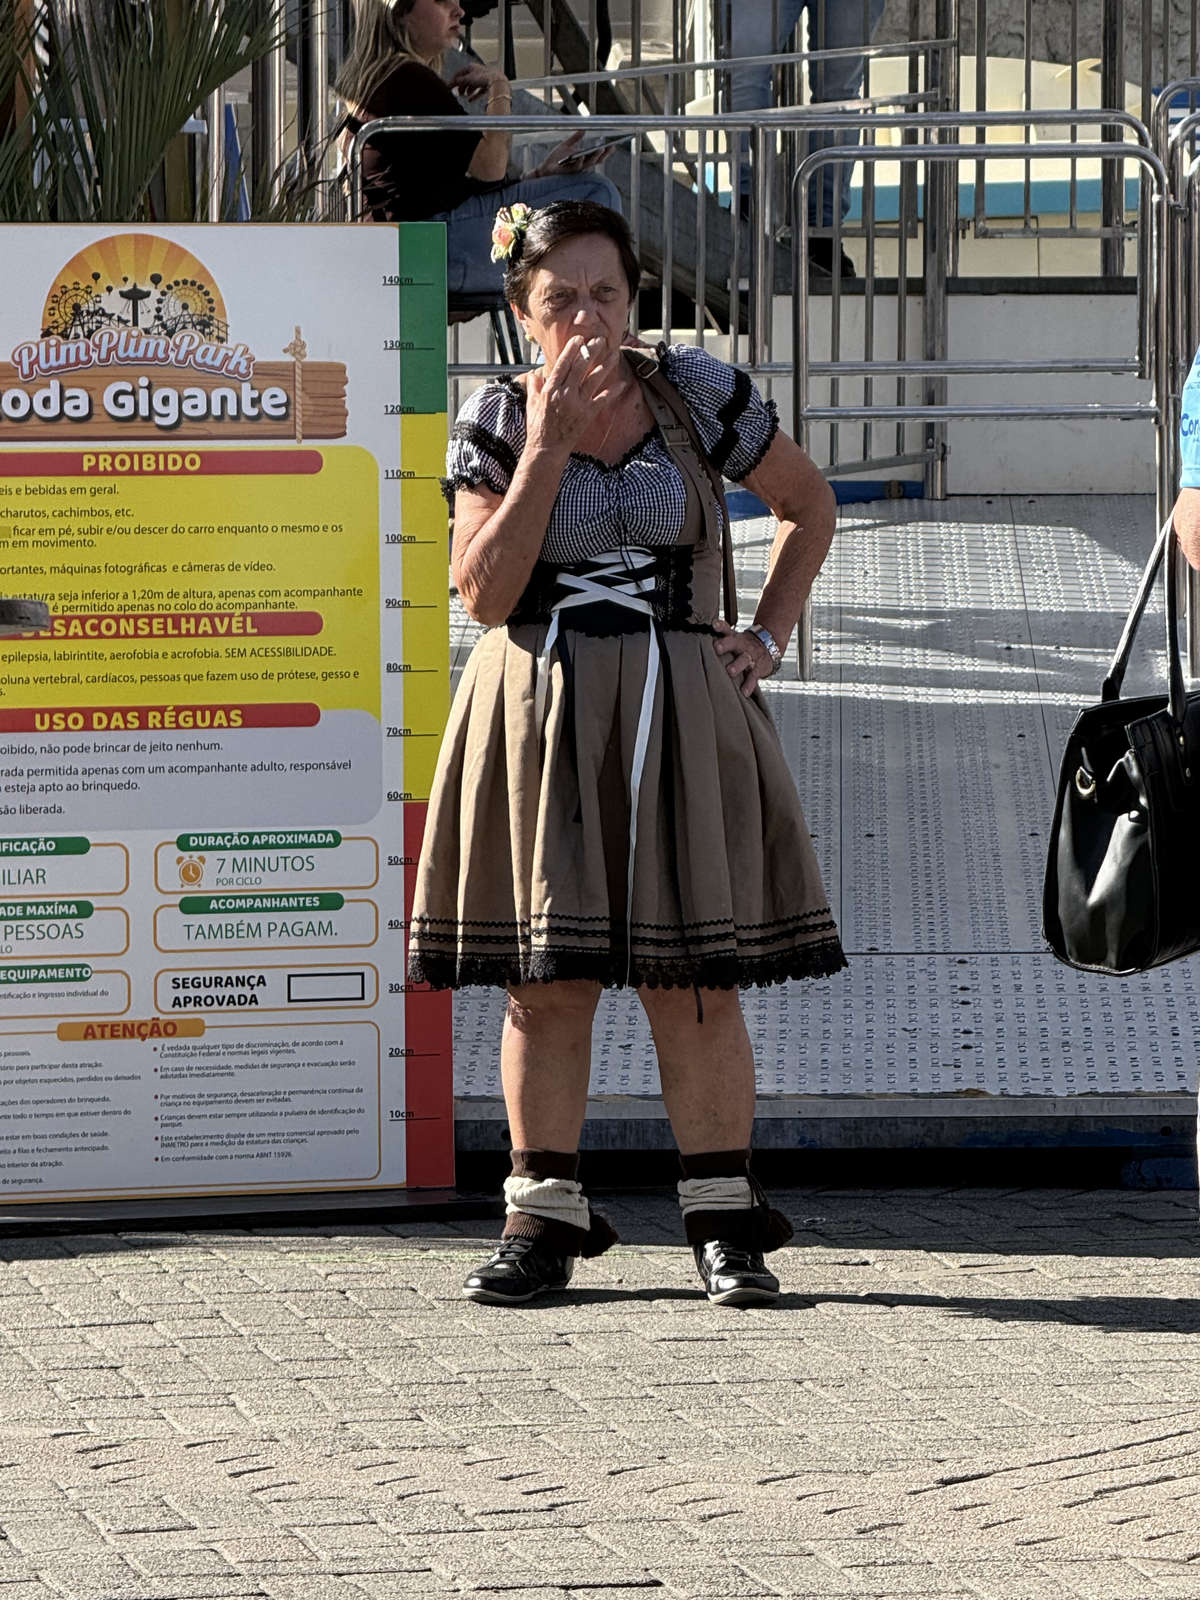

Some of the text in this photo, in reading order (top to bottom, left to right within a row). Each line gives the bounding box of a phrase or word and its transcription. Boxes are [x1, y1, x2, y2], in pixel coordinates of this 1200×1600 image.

[383, 276, 413, 285] 140cm
[383, 340, 414, 349] 130cm
[13, 328, 255, 379] Plim Plim Park
[103, 377, 288, 426] Gigante
[384, 405, 415, 413] 120cm
[83, 453, 200, 471] PROIBIDO
[384, 469, 415, 478] 110cm
[15, 487, 22, 495] e
[24, 484, 67, 495] bebidas
[69, 486, 86, 495] em
[89, 483, 118, 497] geral.
[52, 506, 111, 518] cachimbos,
[114, 507, 133, 517] etc.
[12, 523, 342, 537] ficar em pé, subir e/ou descer do carro enquanto o mesmo e os
[11, 539, 29, 548] em
[32, 537, 96, 548] movimento.
[385, 534, 416, 542] 100cm
[50, 562, 101, 576] máquinas
[104, 561, 167, 575] fotográficas
[172, 564, 178, 572] e
[181, 561, 224, 574] câmeras
[227, 561, 240, 571] de
[243, 560, 275, 571] vídeo.
[58, 590, 78, 602] seja
[81, 589, 120, 602] inferior
[122, 591, 128, 599] a
[132, 588, 164, 601] 1,20m
[166, 587, 180, 599] de
[182, 587, 216, 601] altura,
[218, 589, 255, 601] apenas
[258, 589, 281, 600] com
[283, 586, 363, 599] acompanhante
[52, 600, 297, 614] é permitido apenas no colo do acompanhante.
[385, 598, 410, 607] 90cm
[22, 614, 259, 638] SACONSELHAVÉL
[1, 646, 336, 664] epilepsia, labirintite, aerofobia e acrofobia. SEM ACESSIBILIDADE.
[386, 663, 411, 672] 80cm
[32, 672, 82, 684] vertebral,
[85, 672, 137, 684] cardíacos,
[140, 673, 180, 685] pessoas
[183, 673, 203, 684] que
[206, 670, 237, 681] fazem
[240, 672, 258, 680] uso
[261, 669, 274, 680] de
[277, 669, 318, 682] prótese,
[320, 670, 350, 681] gesso
[352, 670, 359, 679] e
[35, 706, 244, 732] USO DAS RÉGUAS
[386, 727, 412, 736] 70cm
[40, 743, 60, 753] não
[63, 742, 90, 755] pode
[93, 742, 130, 753] brincar
[133, 741, 146, 752] de
[148, 741, 172, 754] jeito
[176, 739, 222, 751] nenhum.
[27, 764, 78, 779] permitida
[81, 766, 119, 777] apenas
[121, 766, 145, 775] com
[148, 765, 165, 774] um
[168, 761, 247, 775] acompanhante
[250, 760, 286, 772] adulto,
[289, 759, 351, 773] responsável
[4, 779, 140, 794] esteja apto ao brinquedo.
[387, 791, 412, 800] 60cm
[19, 803, 64, 814] liberada.
[189, 832, 335, 848] DURAÇÃO APROXIMADA
[216, 855, 314, 873] 7 MINUTOS
[388, 856, 413, 864] 50cm
[216, 876, 261, 886] POR CICLO
[27, 901, 78, 916] MAXÍMA
[209, 896, 319, 909] ACOMPANHANTES
[4, 922, 83, 941] PESSOAS
[183, 919, 338, 940] TAMBÉM PAGAM.
[172, 974, 266, 990] SEGURANÇA
[389, 984, 414, 992] 30cm
[172, 993, 258, 1008] APROVADA
[83, 1017, 177, 1041] ATENÇÃO
[389, 1047, 414, 1056] 20cm
[389, 1110, 414, 1119] 10cm
